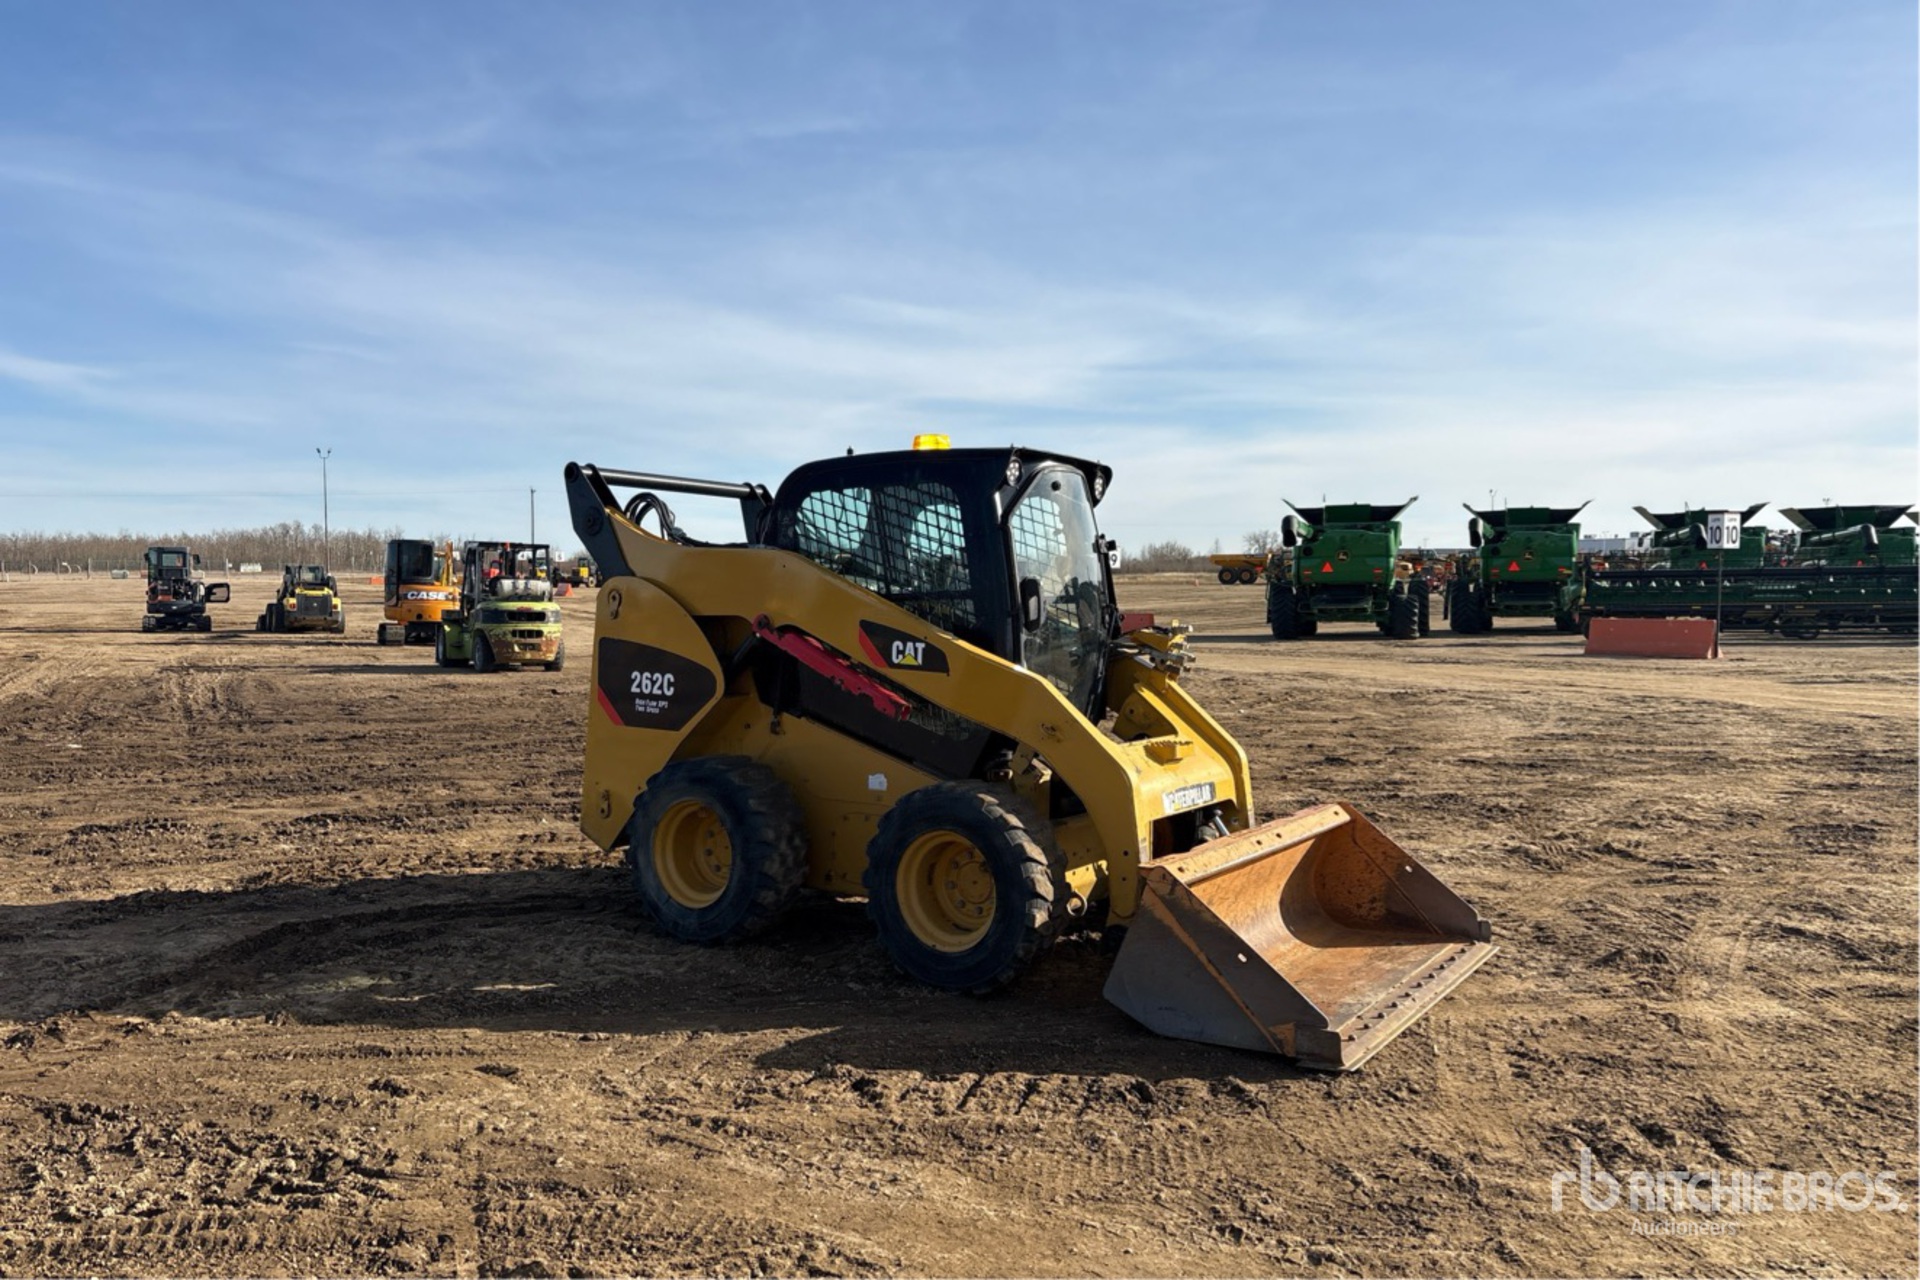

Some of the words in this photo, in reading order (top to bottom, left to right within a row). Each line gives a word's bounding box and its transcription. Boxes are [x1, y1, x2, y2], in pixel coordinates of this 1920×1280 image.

[1709, 525, 1722, 544] 10
[1725, 525, 1738, 544] 10
[1110, 553, 1118, 567] 9
[407, 591, 447, 600] CASE
[892, 640, 926, 665] CAT
[630, 671, 675, 696] 262C
